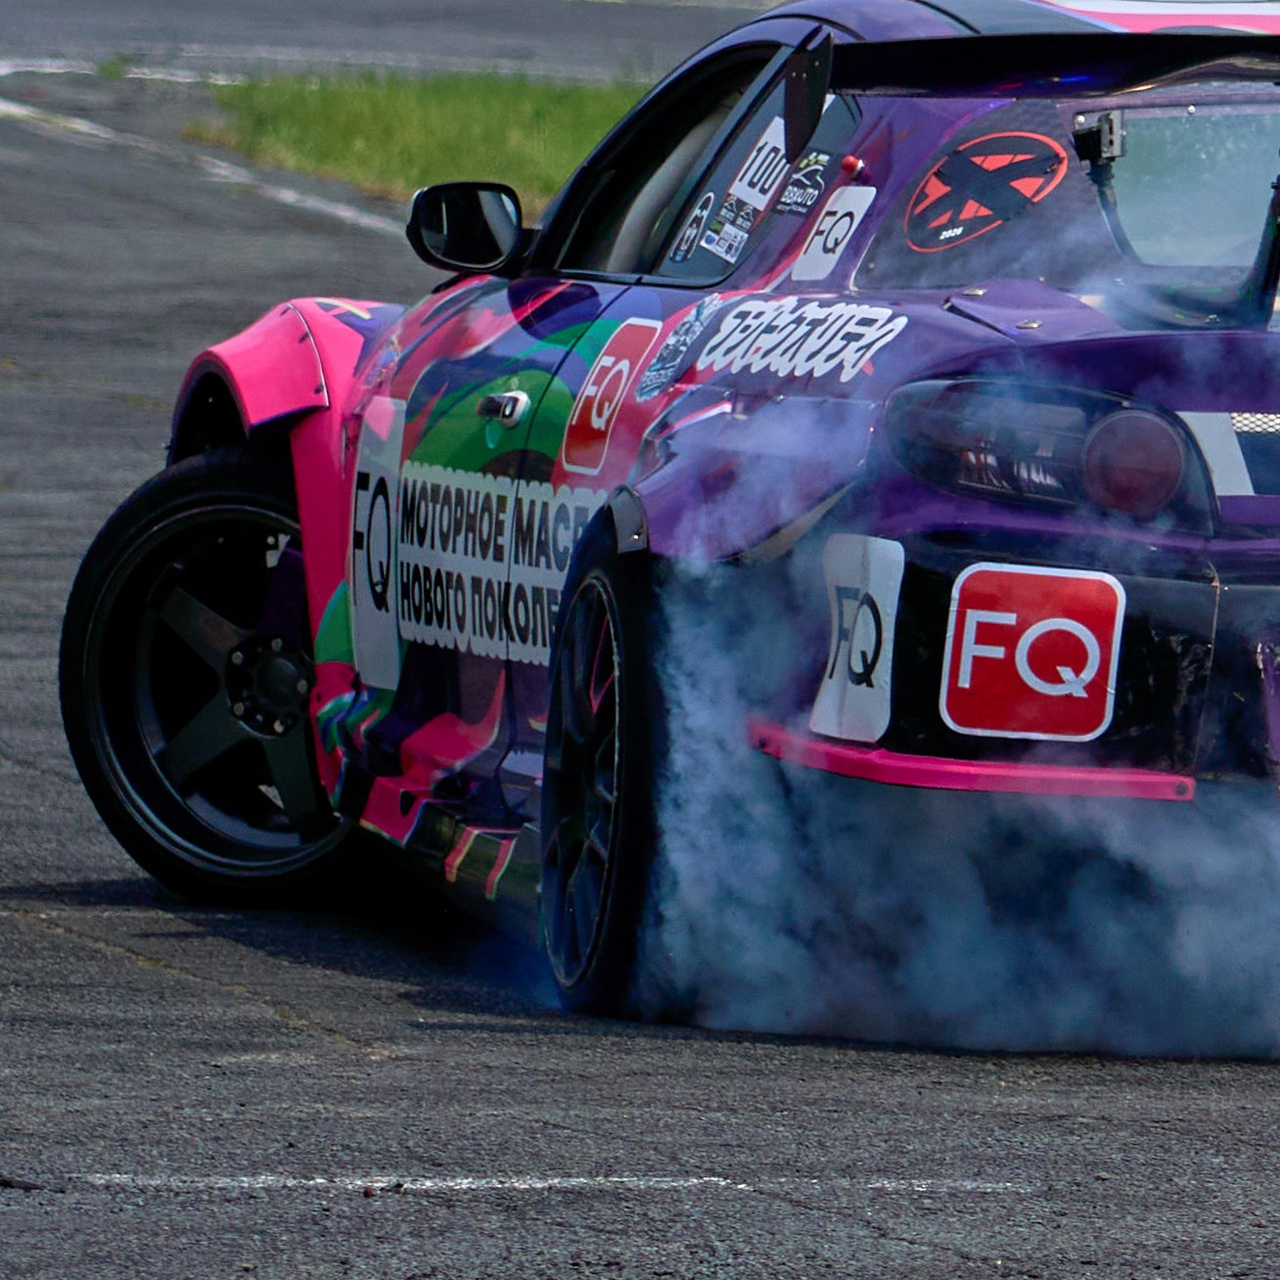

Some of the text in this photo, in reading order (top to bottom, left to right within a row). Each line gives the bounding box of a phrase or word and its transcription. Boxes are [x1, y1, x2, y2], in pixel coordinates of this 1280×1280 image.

[803, 210, 855, 255] FQ
[571, 355, 630, 431] FQ
[353, 472, 391, 614] FQ
[400, 476, 509, 564] МОТОРНОЕ
[400, 560, 467, 634] НОВОГО
[829, 586, 882, 689] FQ
[958, 609, 1100, 698] FQ
